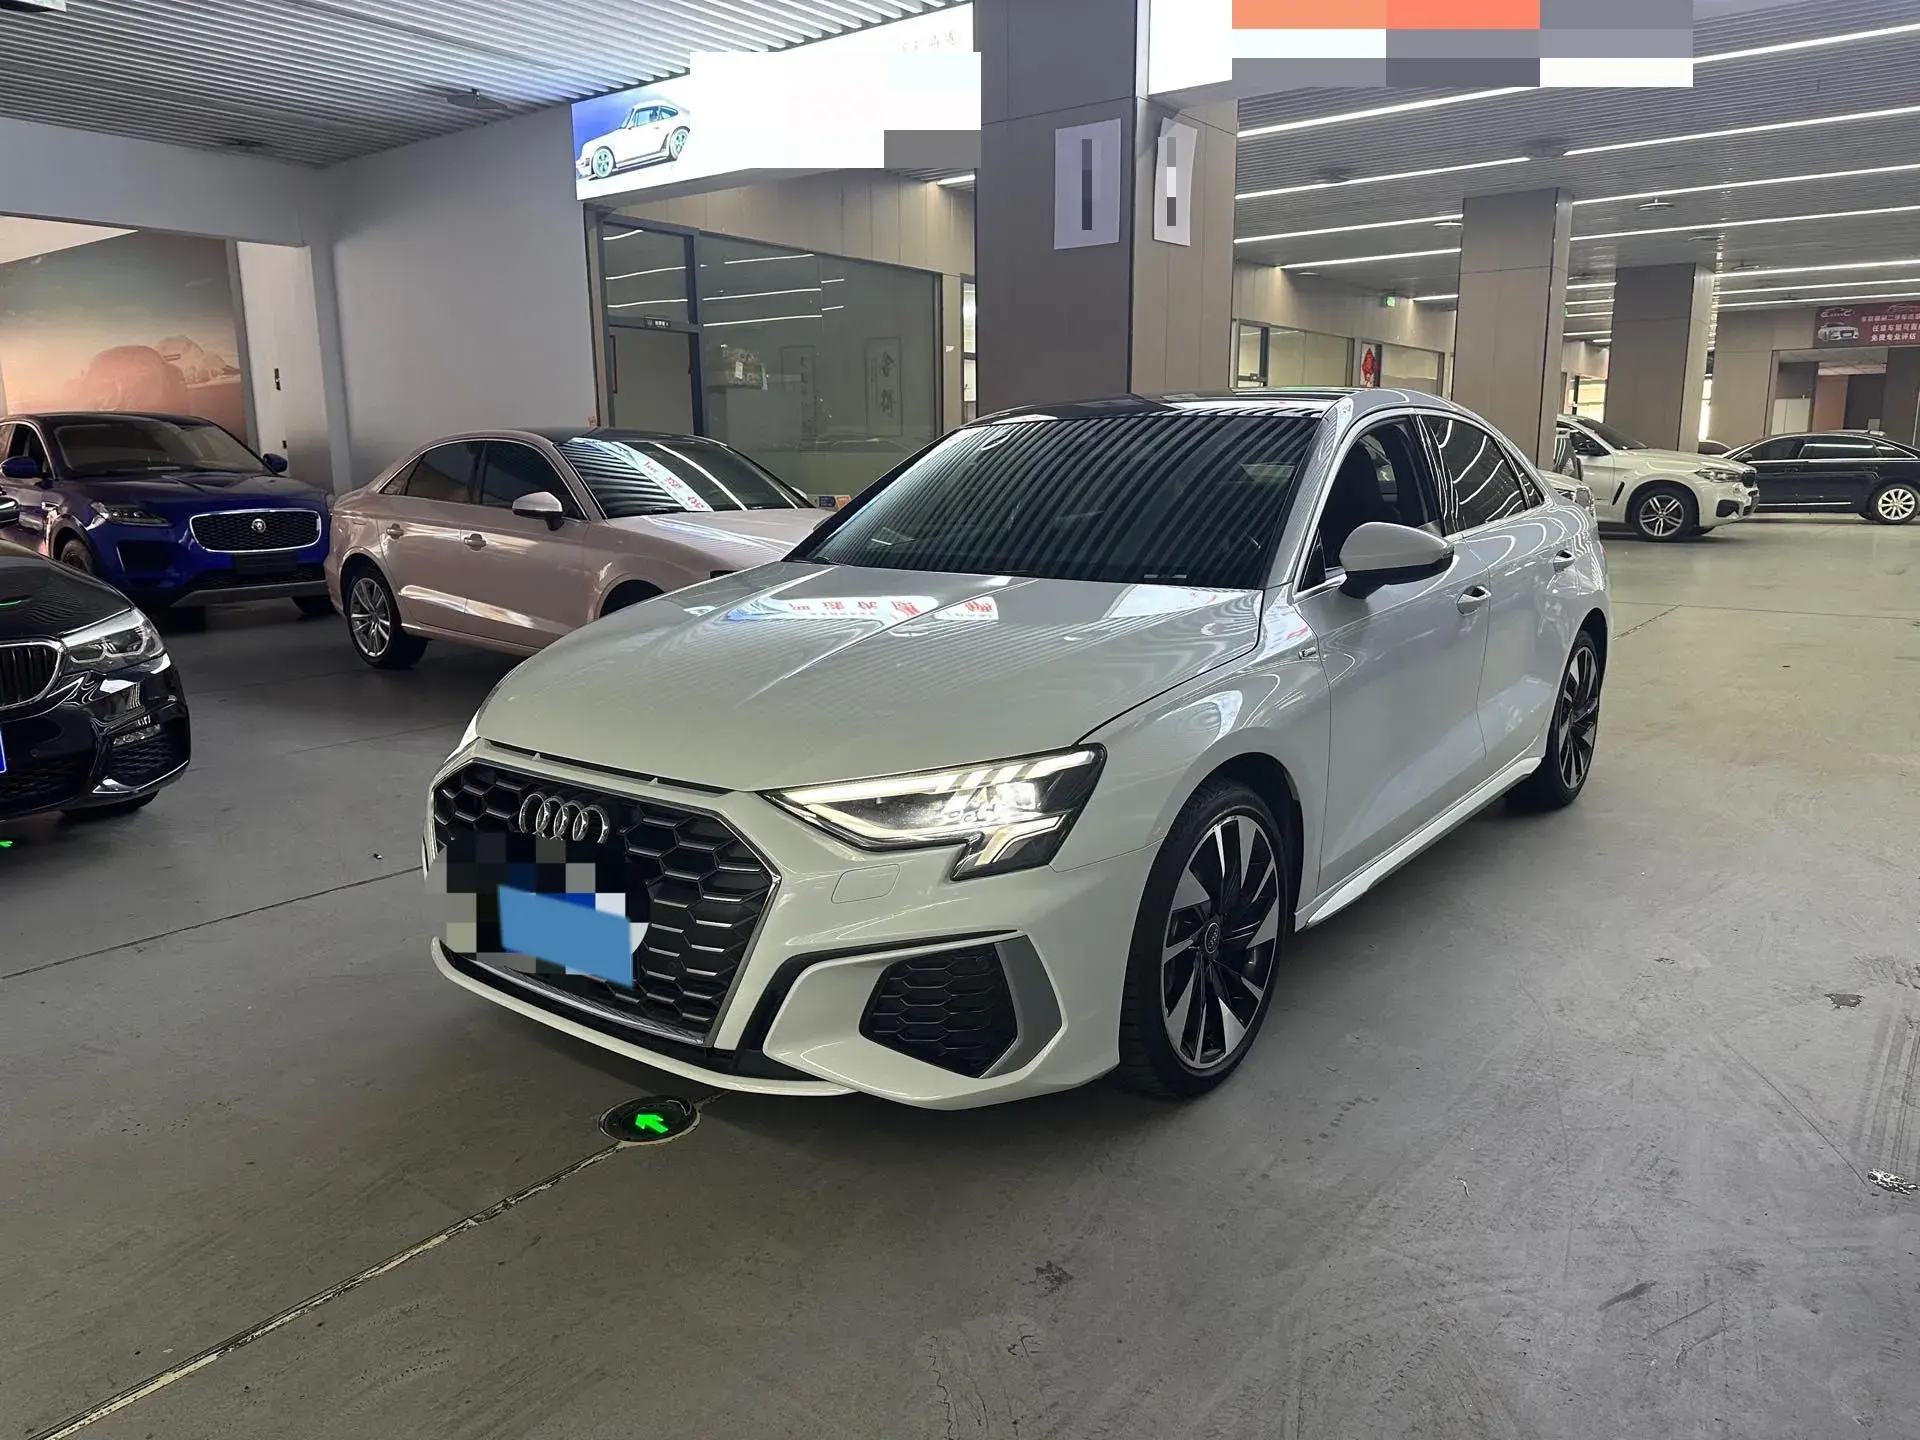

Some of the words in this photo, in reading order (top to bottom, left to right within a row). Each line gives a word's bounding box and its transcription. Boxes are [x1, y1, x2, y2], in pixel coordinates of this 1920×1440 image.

[1871, 333, 1917, 342] 免费专业评估
